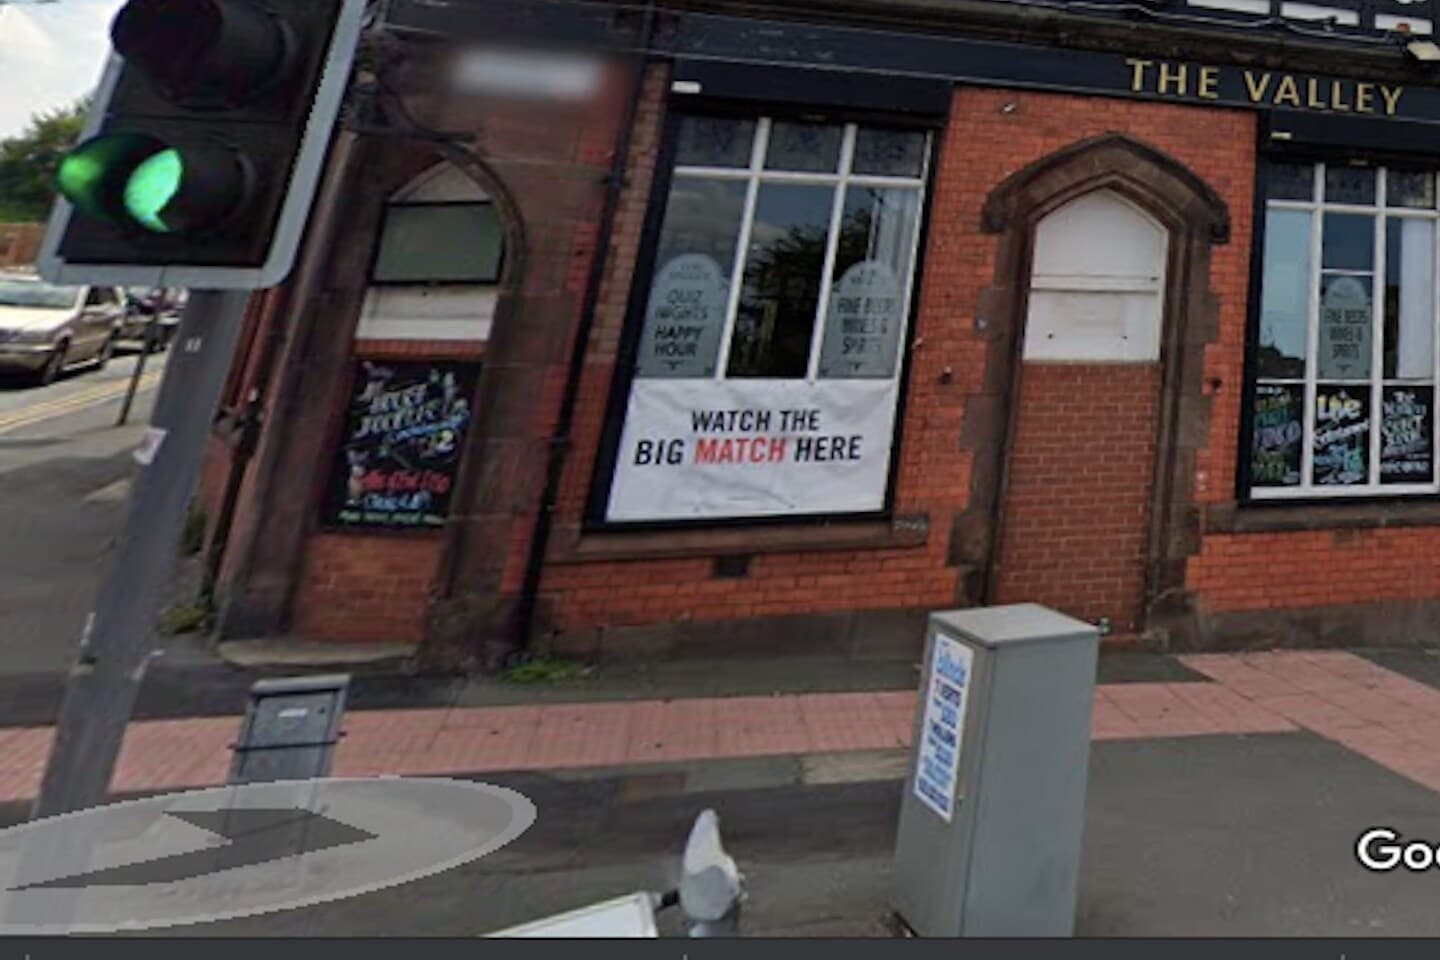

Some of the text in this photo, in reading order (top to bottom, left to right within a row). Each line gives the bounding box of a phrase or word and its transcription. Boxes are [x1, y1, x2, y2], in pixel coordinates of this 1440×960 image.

[1126, 58, 1404, 116] THE VALLEY
[655, 324, 705, 340] HAPPY
[654, 341, 698, 357] HOUR
[691, 408, 822, 433] WATCH THE
[633, 435, 864, 466] BIG MATCH HERE
